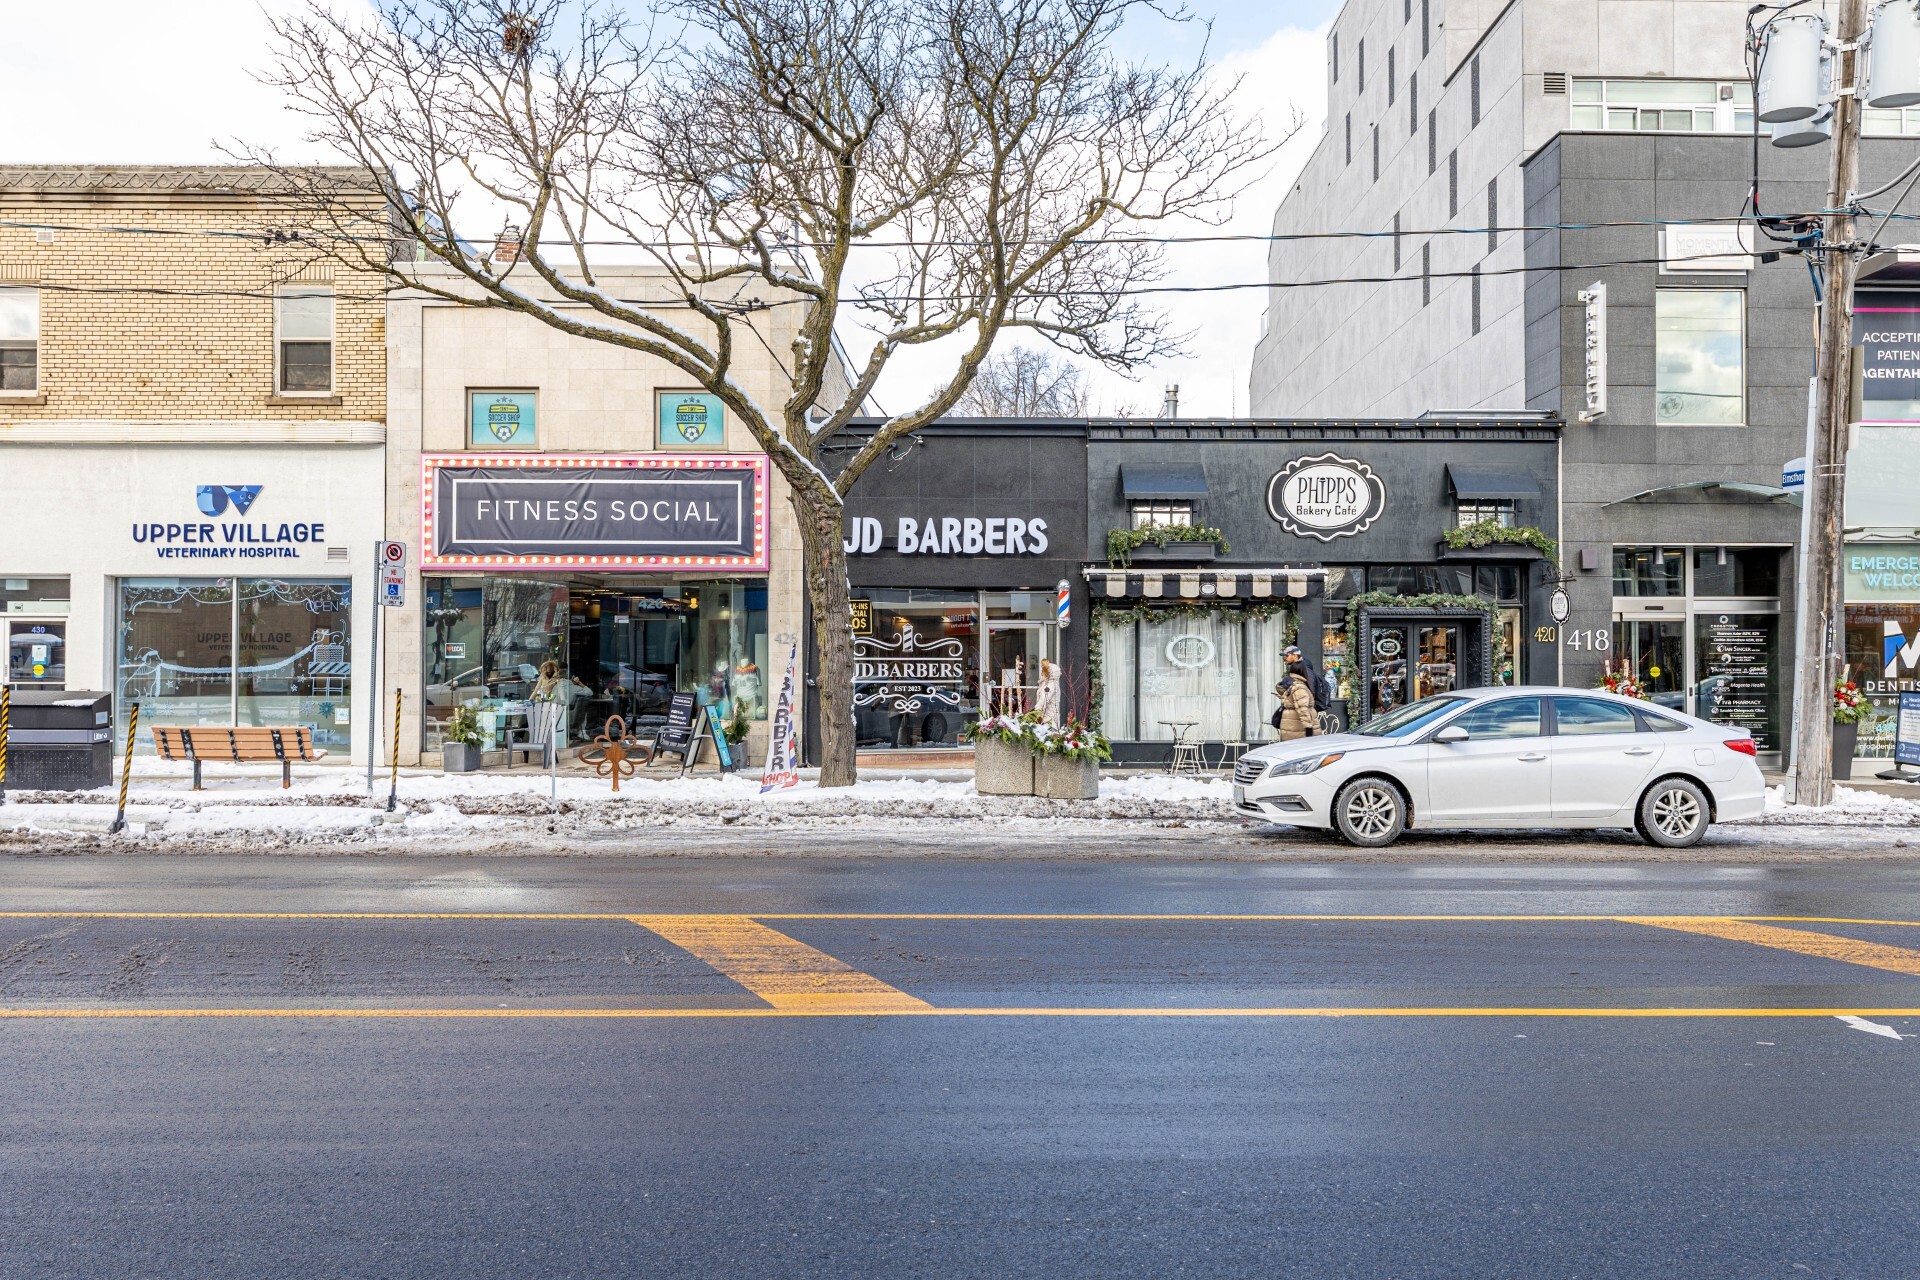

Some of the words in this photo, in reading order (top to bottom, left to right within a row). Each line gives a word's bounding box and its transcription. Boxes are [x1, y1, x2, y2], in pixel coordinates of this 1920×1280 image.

[488, 413, 507, 422] SOCCER
[507, 413, 521, 422] SHOP
[676, 413, 694, 422] SOCCER
[695, 413, 708, 422] SHOP
[1297, 477, 1356, 504] PHIPPS
[477, 500, 598, 521] FITNESS
[610, 501, 719, 522] SOCIAL
[1296, 505, 1332, 517] Bakery
[1334, 506, 1357, 516] Café
[132, 523, 215, 543] UPPER
[222, 523, 325, 543] VILLAGE
[844, 517, 882, 553] JD
[898, 517, 1049, 554] BARBERS
[157, 547, 236, 558] VETERINARY
[239, 547, 300, 558] HOSPITAL
[1851, 556, 1920, 570] EMERGE
[305, 600, 339, 612] OPEN
[638, 598, 664, 609] 426
[31, 626, 46, 634] 430
[1534, 626, 1555, 642] 420
[197, 633, 232, 643] UPPE
[1566, 629, 1610, 651] 418
[853, 663, 874, 678] JD
[877, 663, 963, 678] BARBERS
[762, 772, 791, 786] SHOP
